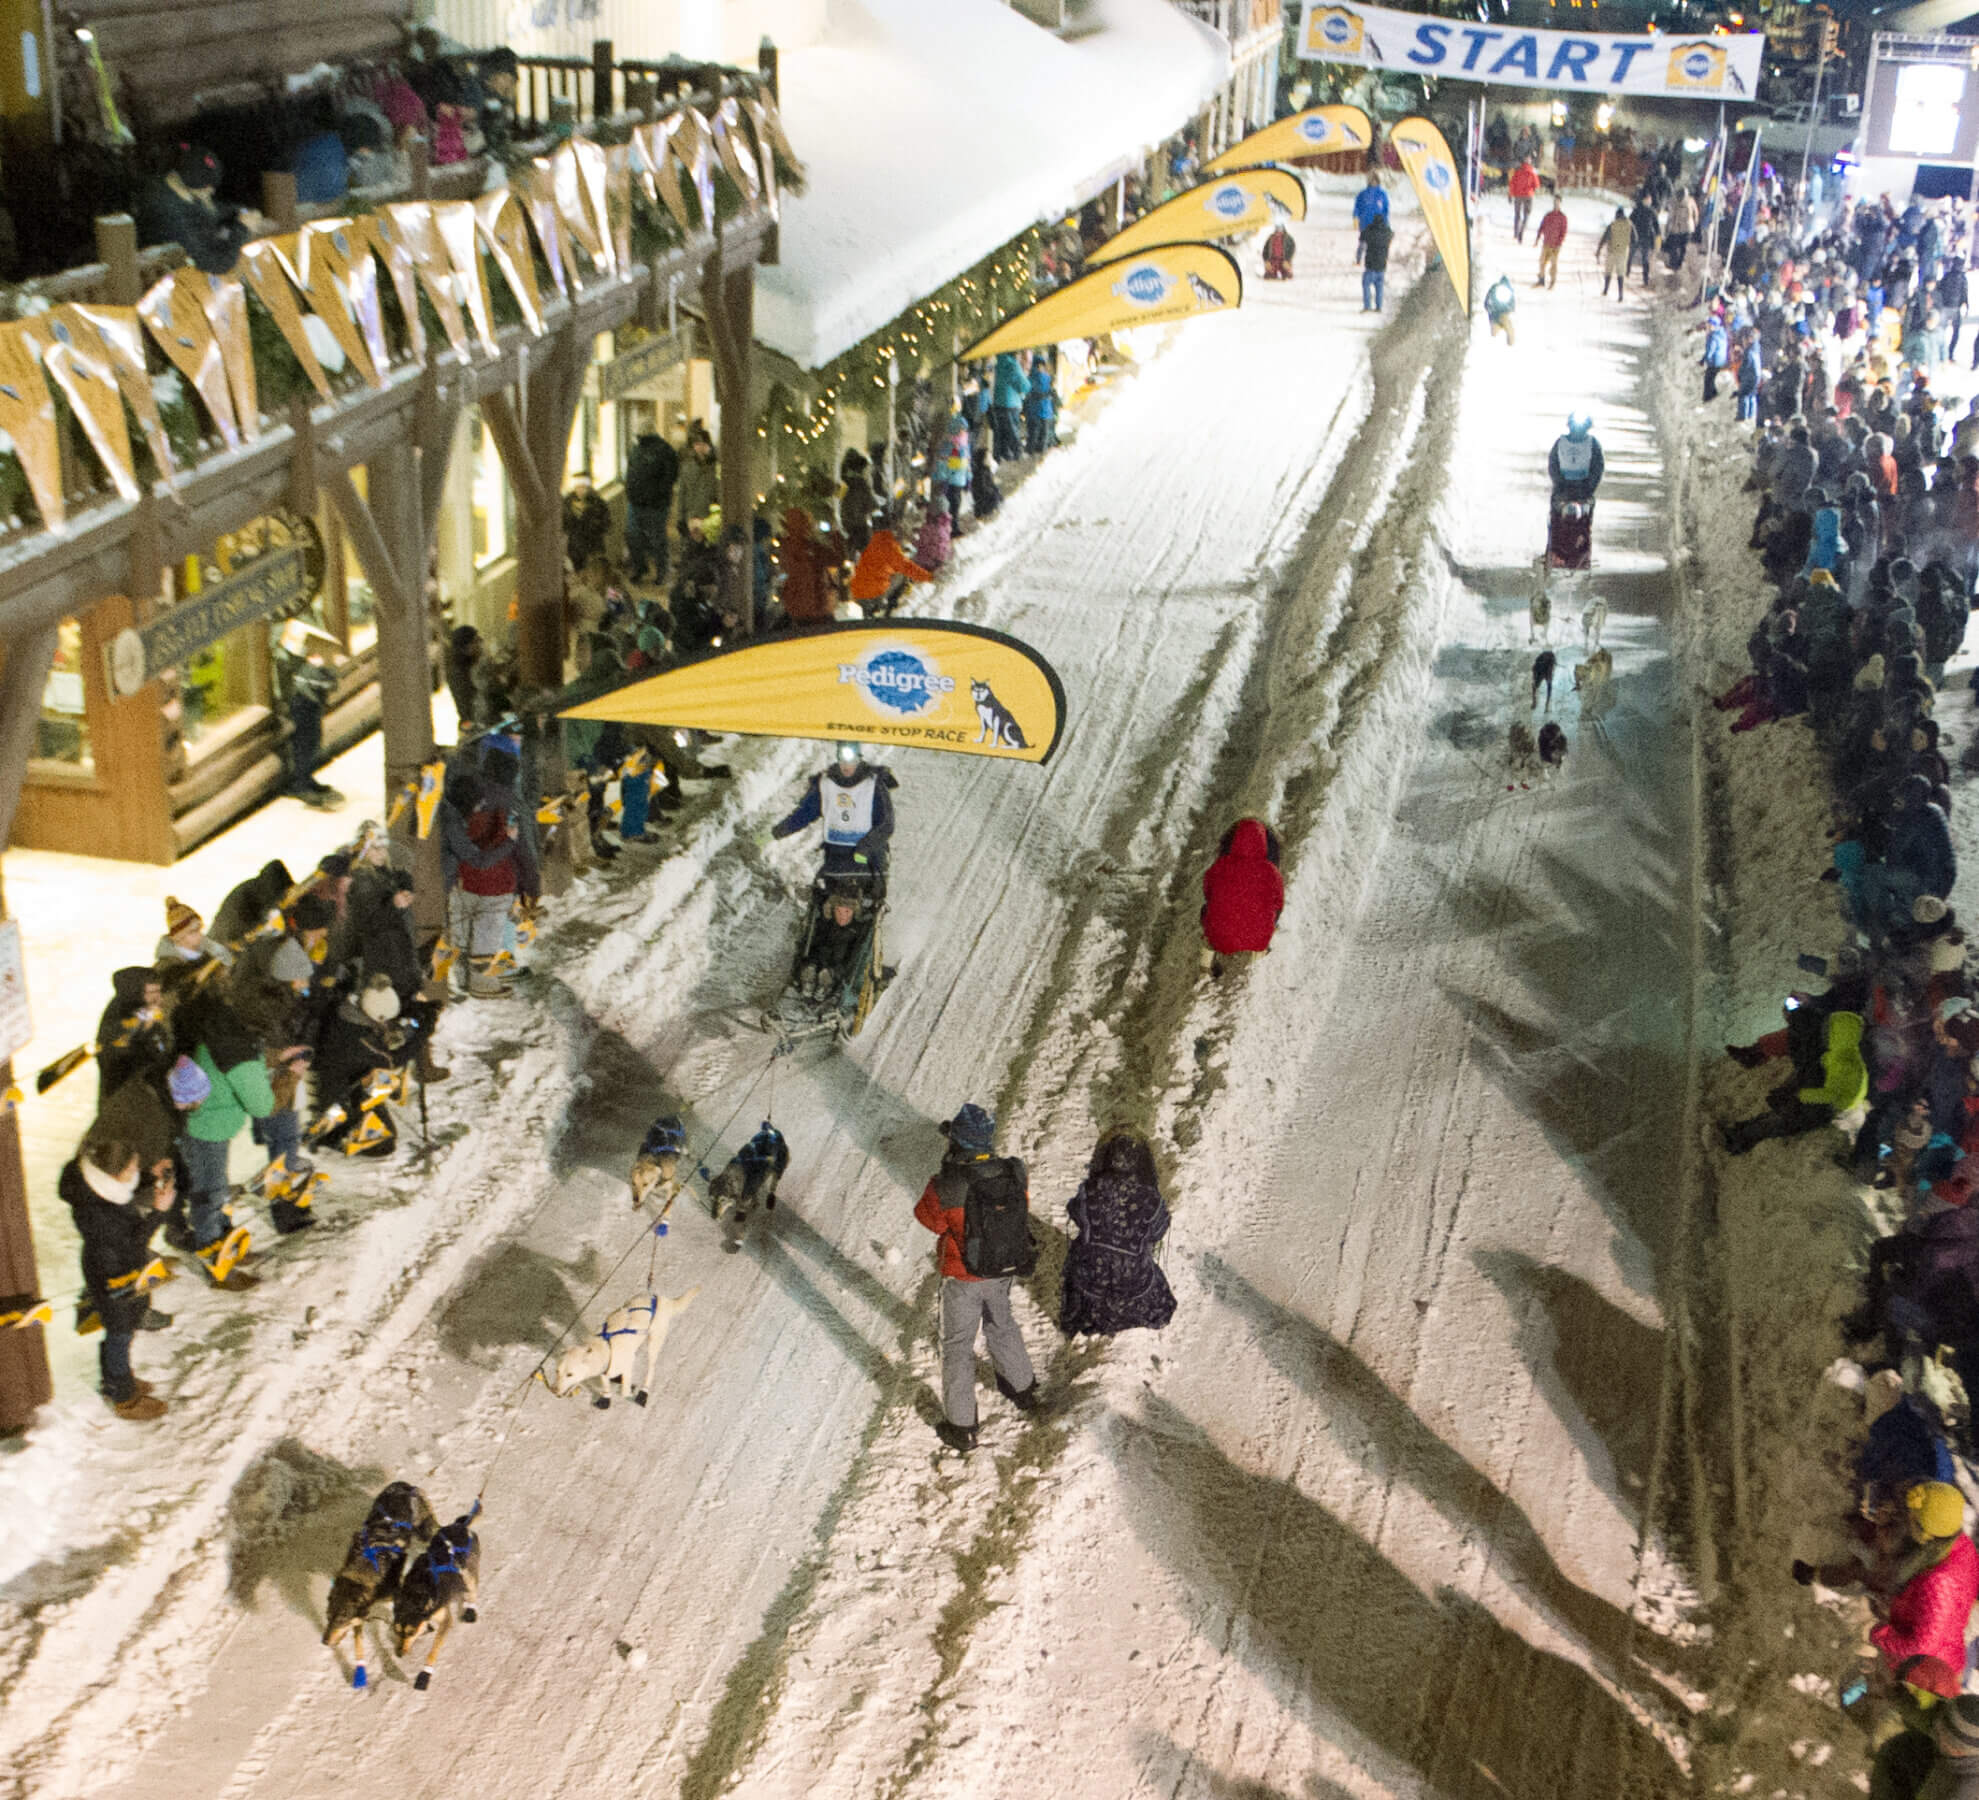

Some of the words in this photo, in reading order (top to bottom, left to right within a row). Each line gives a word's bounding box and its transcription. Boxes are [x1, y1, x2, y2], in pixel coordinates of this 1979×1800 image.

[1407, 23, 1654, 84] START
[837, 664, 955, 692] Pedigree
[880, 726, 921, 737] STOP
[924, 728, 968, 743] RACE
[841, 810, 850, 822] 6
